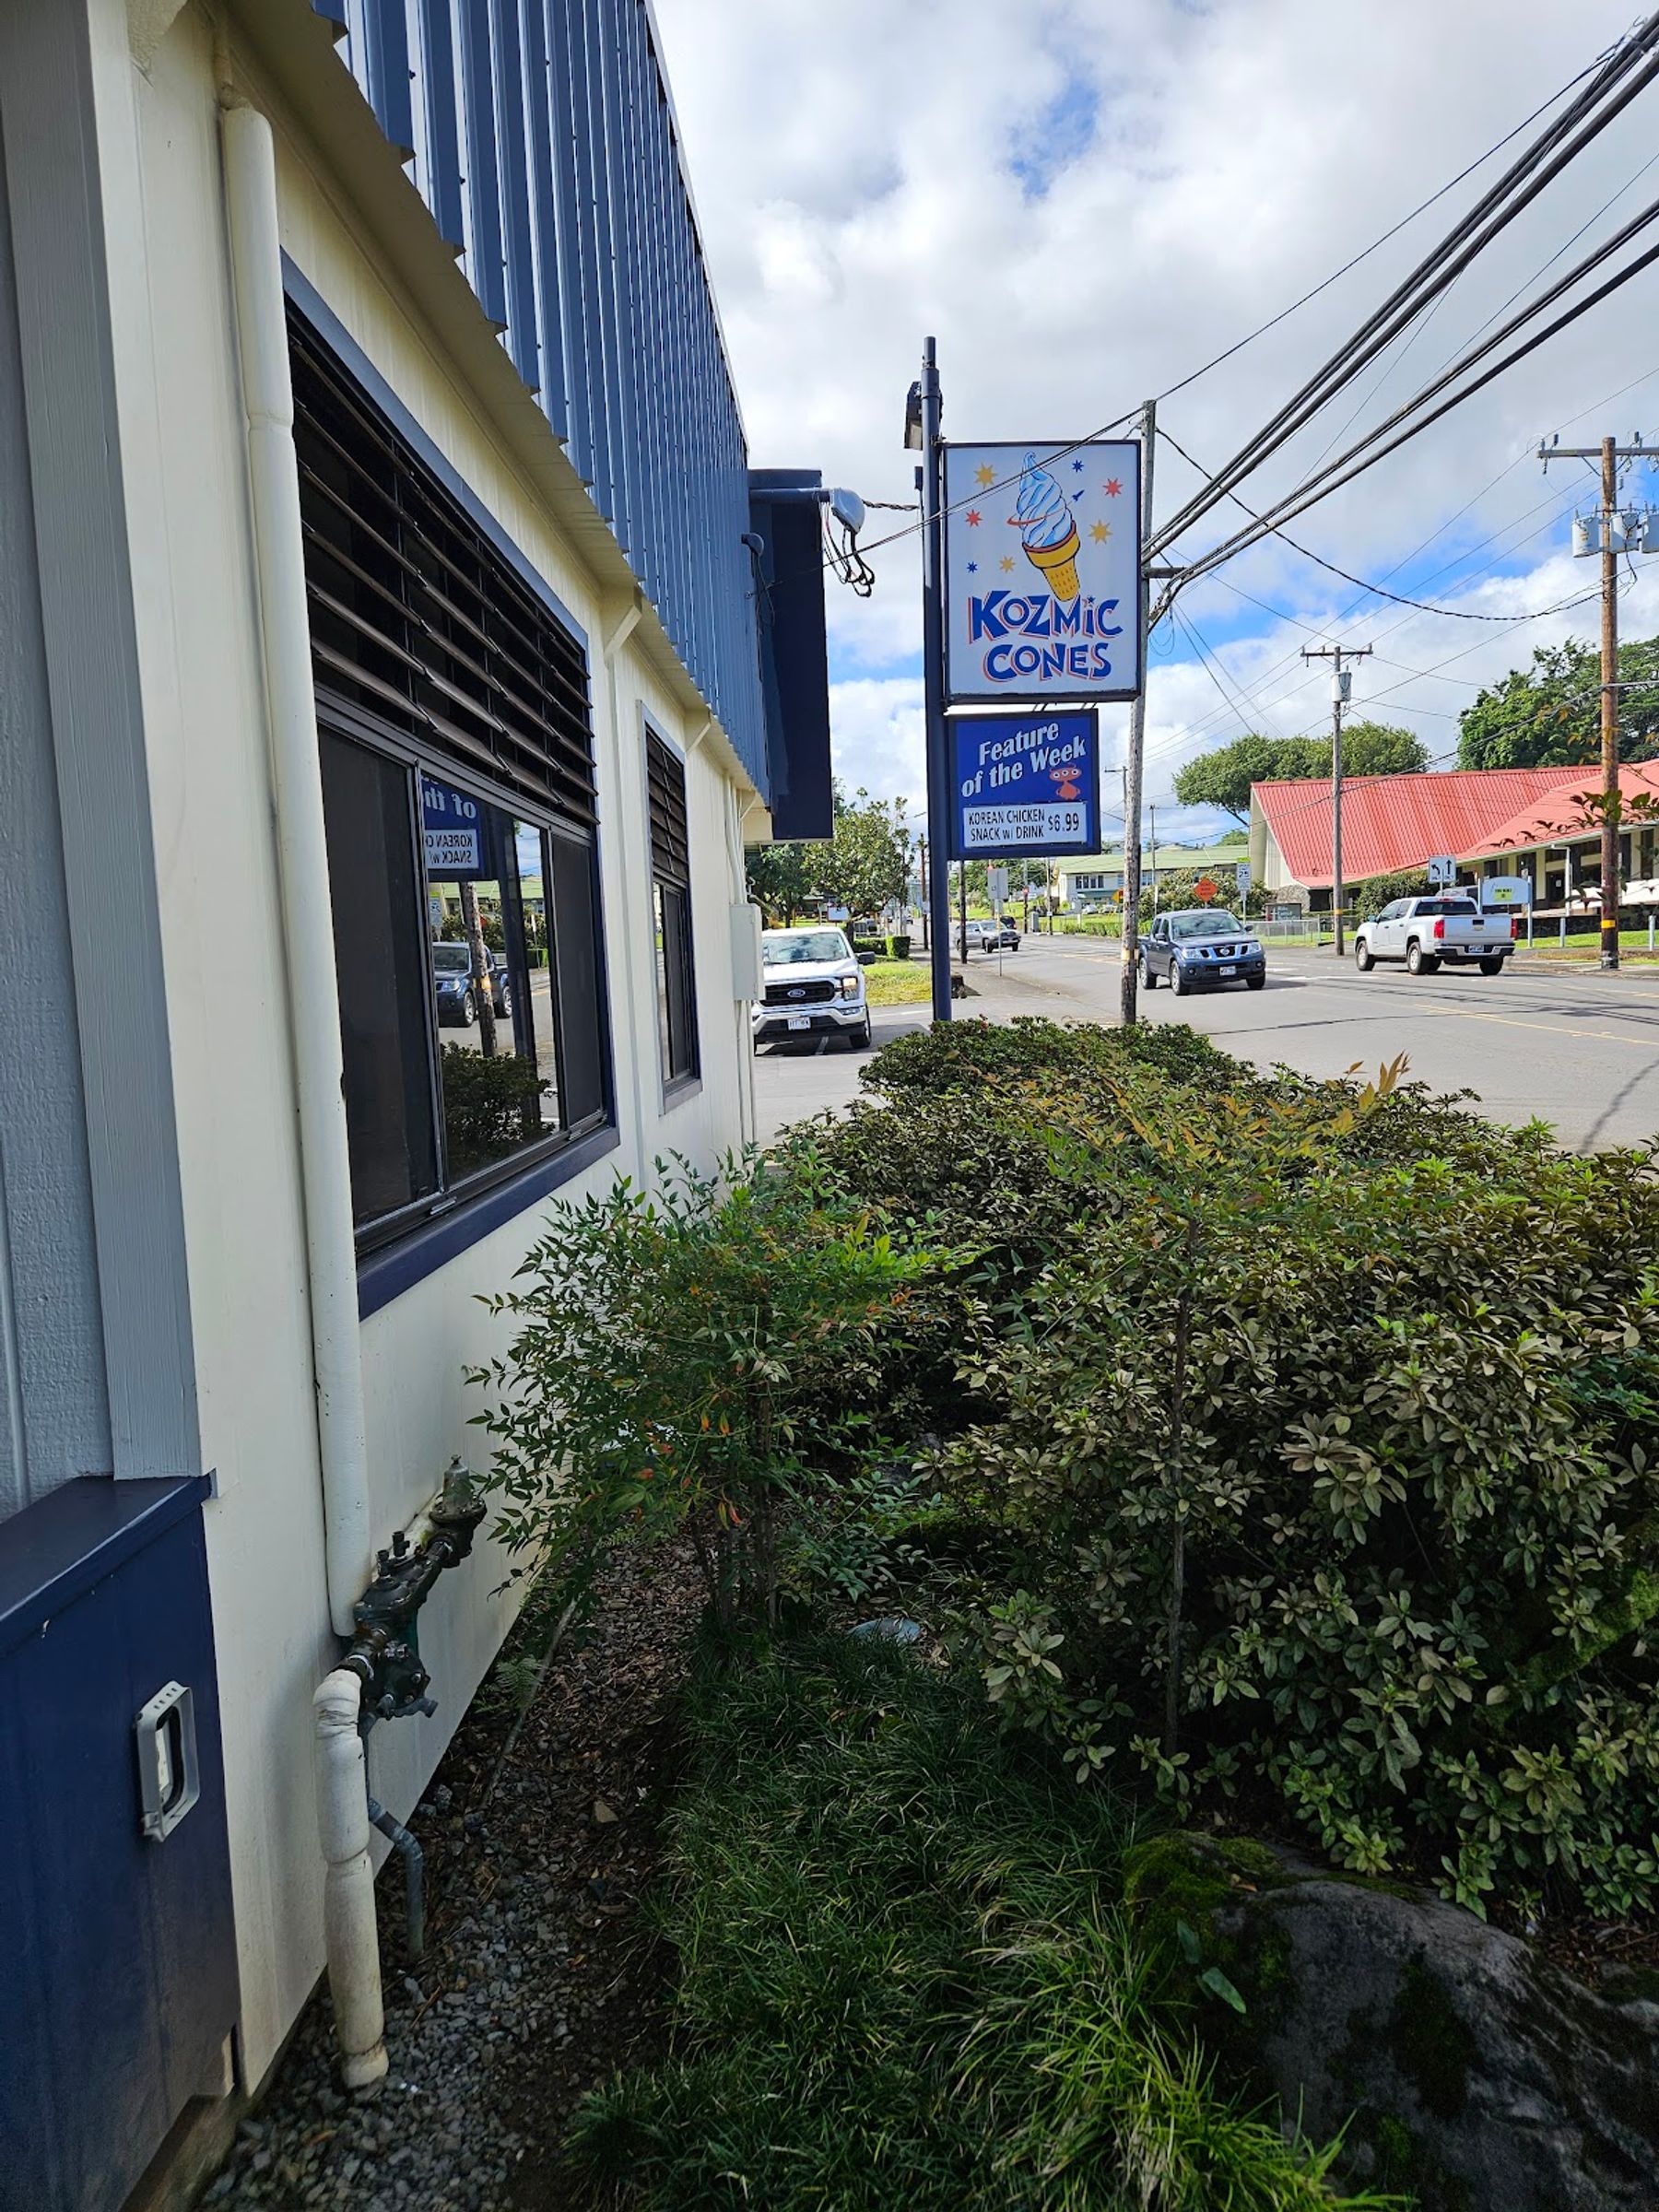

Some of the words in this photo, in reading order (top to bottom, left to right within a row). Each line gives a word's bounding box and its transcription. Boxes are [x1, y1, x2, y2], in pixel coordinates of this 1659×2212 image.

[983, 642, 1112, 682] CONES
[979, 723, 1059, 766] Feature
[961, 770, 983, 797] of
[989, 761, 1023, 788] the
[1030, 735, 1086, 772] Week
[969, 810, 1005, 826] KOREAN
[1006, 808, 1045, 824] CHICKEN
[1047, 812, 1079, 832] $6.99
[971, 828, 1000, 841] SNACK
[1016, 825, 1045, 839] DRINK
